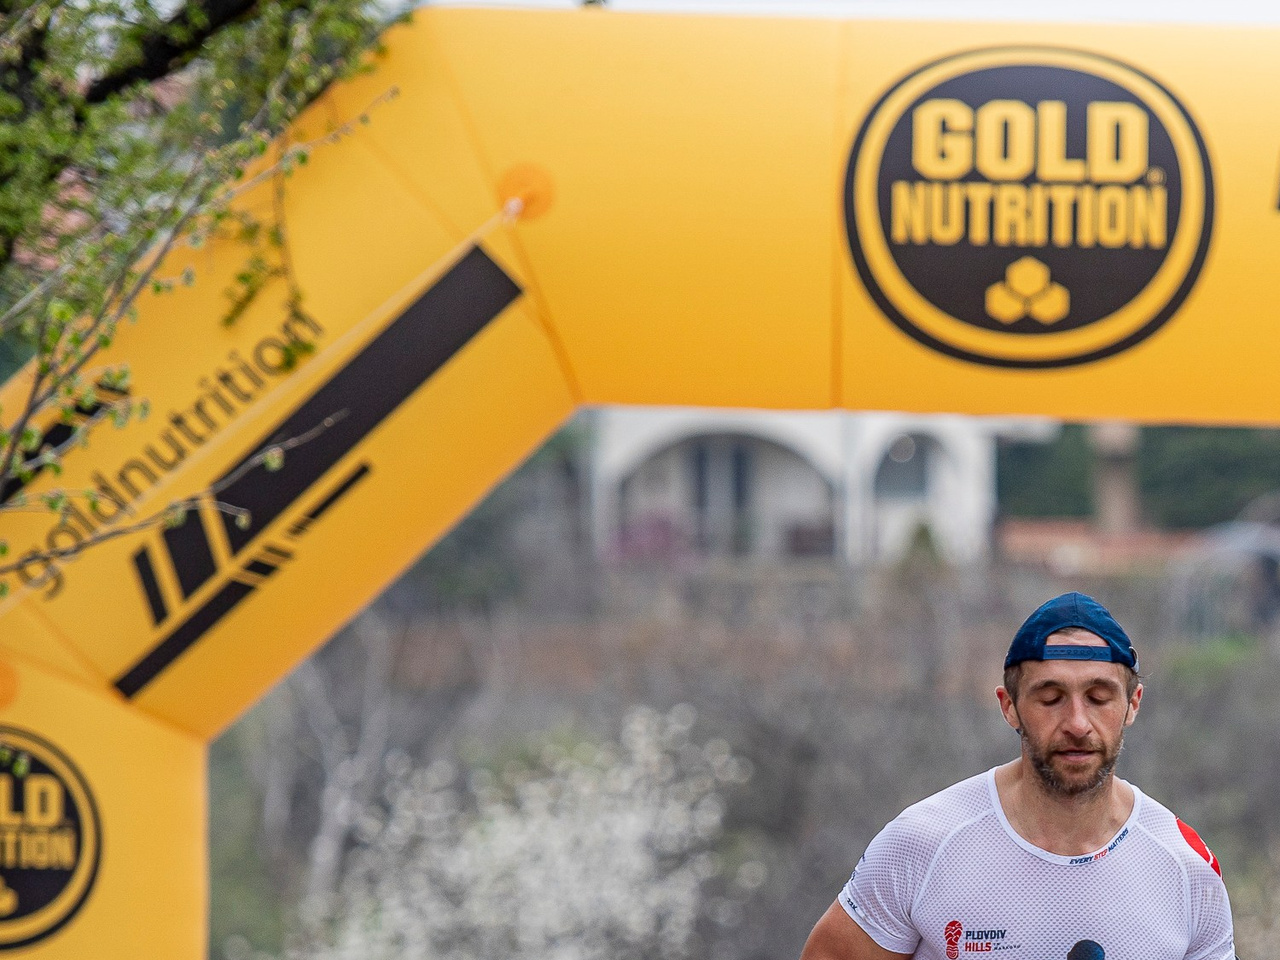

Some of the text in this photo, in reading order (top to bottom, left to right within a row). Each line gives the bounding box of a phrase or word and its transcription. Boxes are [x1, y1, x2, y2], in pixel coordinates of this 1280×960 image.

[912, 98, 1149, 183] GOLD
[891, 179, 1168, 249] NUTRITION
[17, 308, 325, 600] goldnutrition
[1069, 827, 1129, 865] EVERY STEP MATTERS
[964, 942, 992, 952] HILLS
[965, 930, 1007, 941] PLOVDIV
